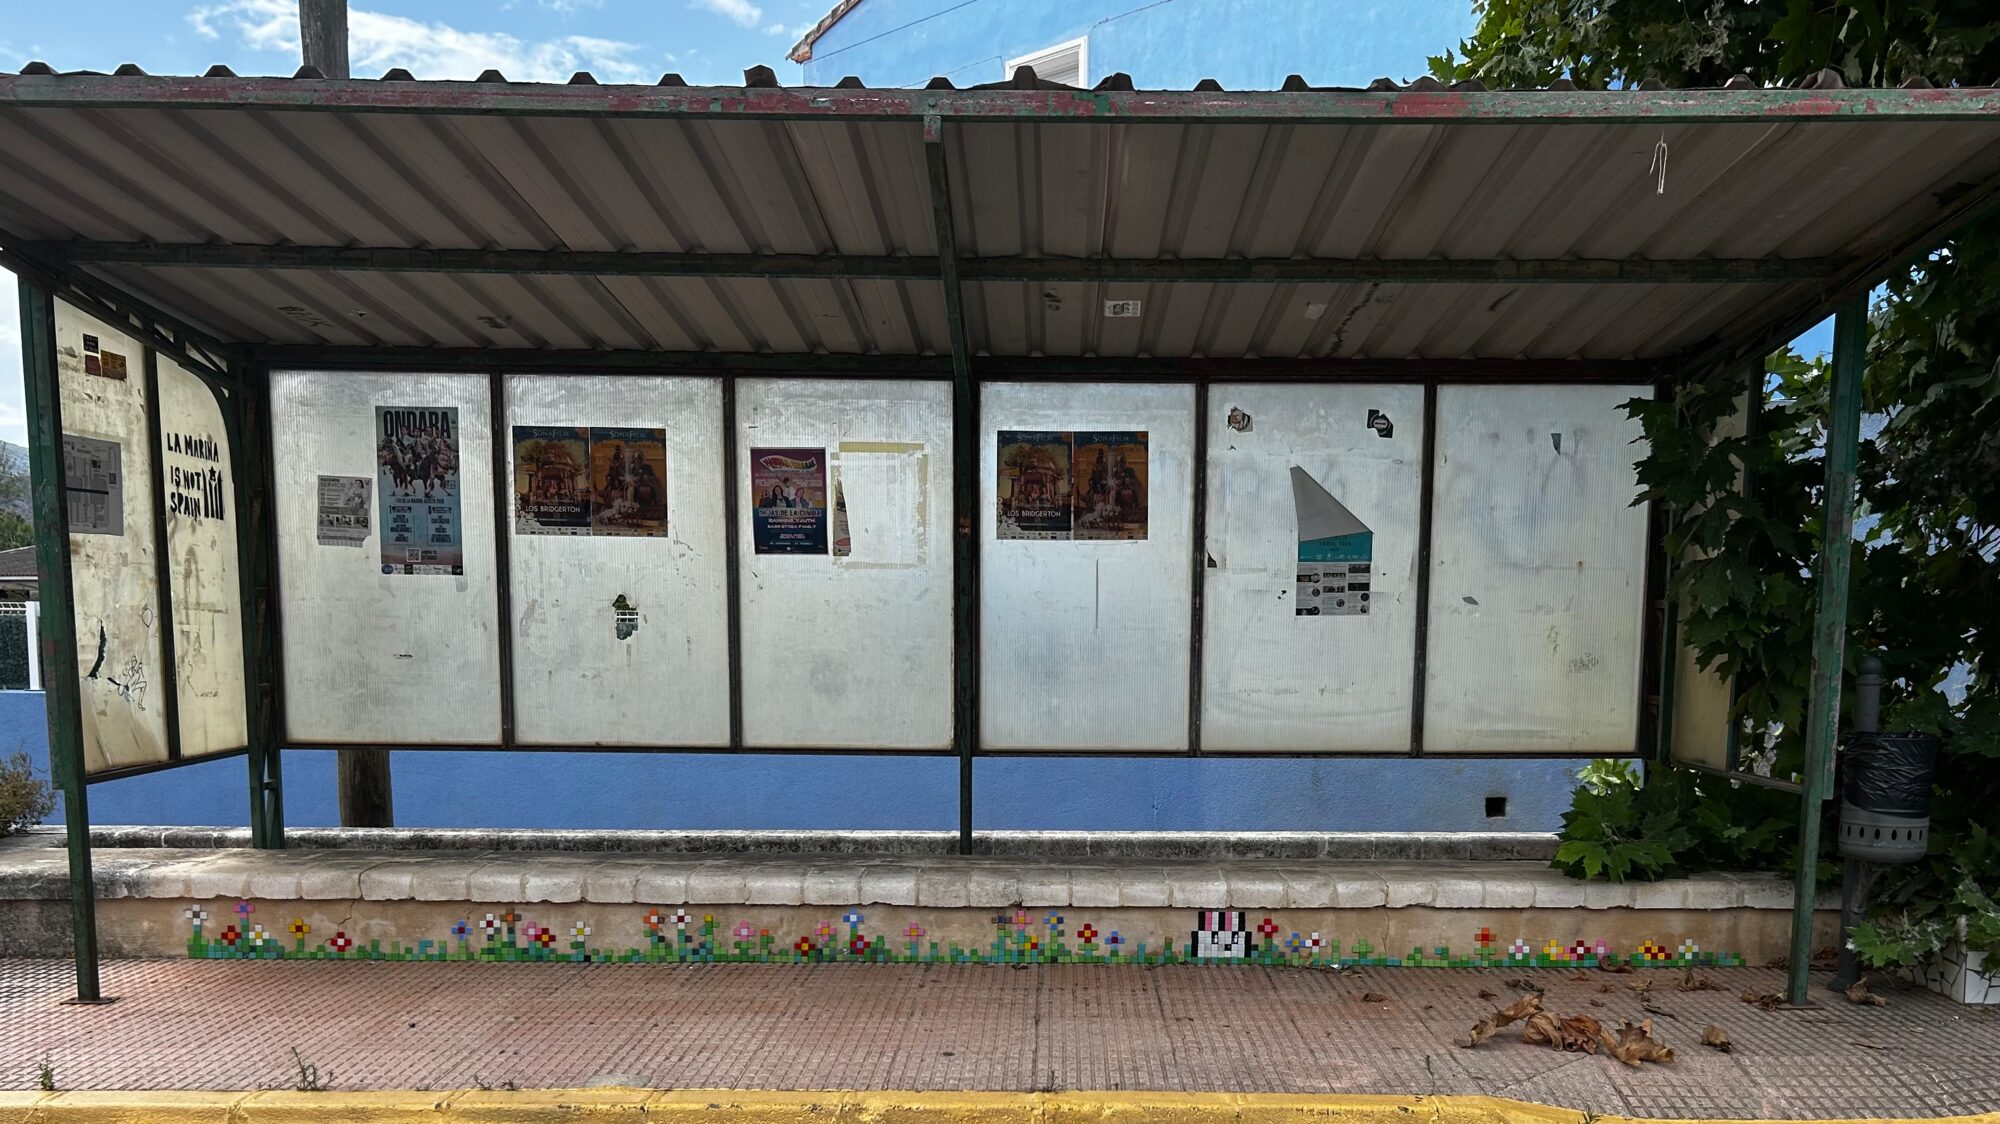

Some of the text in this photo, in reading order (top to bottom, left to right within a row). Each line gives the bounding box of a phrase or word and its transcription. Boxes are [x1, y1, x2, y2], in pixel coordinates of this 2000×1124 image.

[383, 410, 451, 440] ONDARA
[167, 432, 220, 463] LA MARINA
[170, 465, 201, 491] IS NOT
[170, 491, 201, 518] SPAIN
